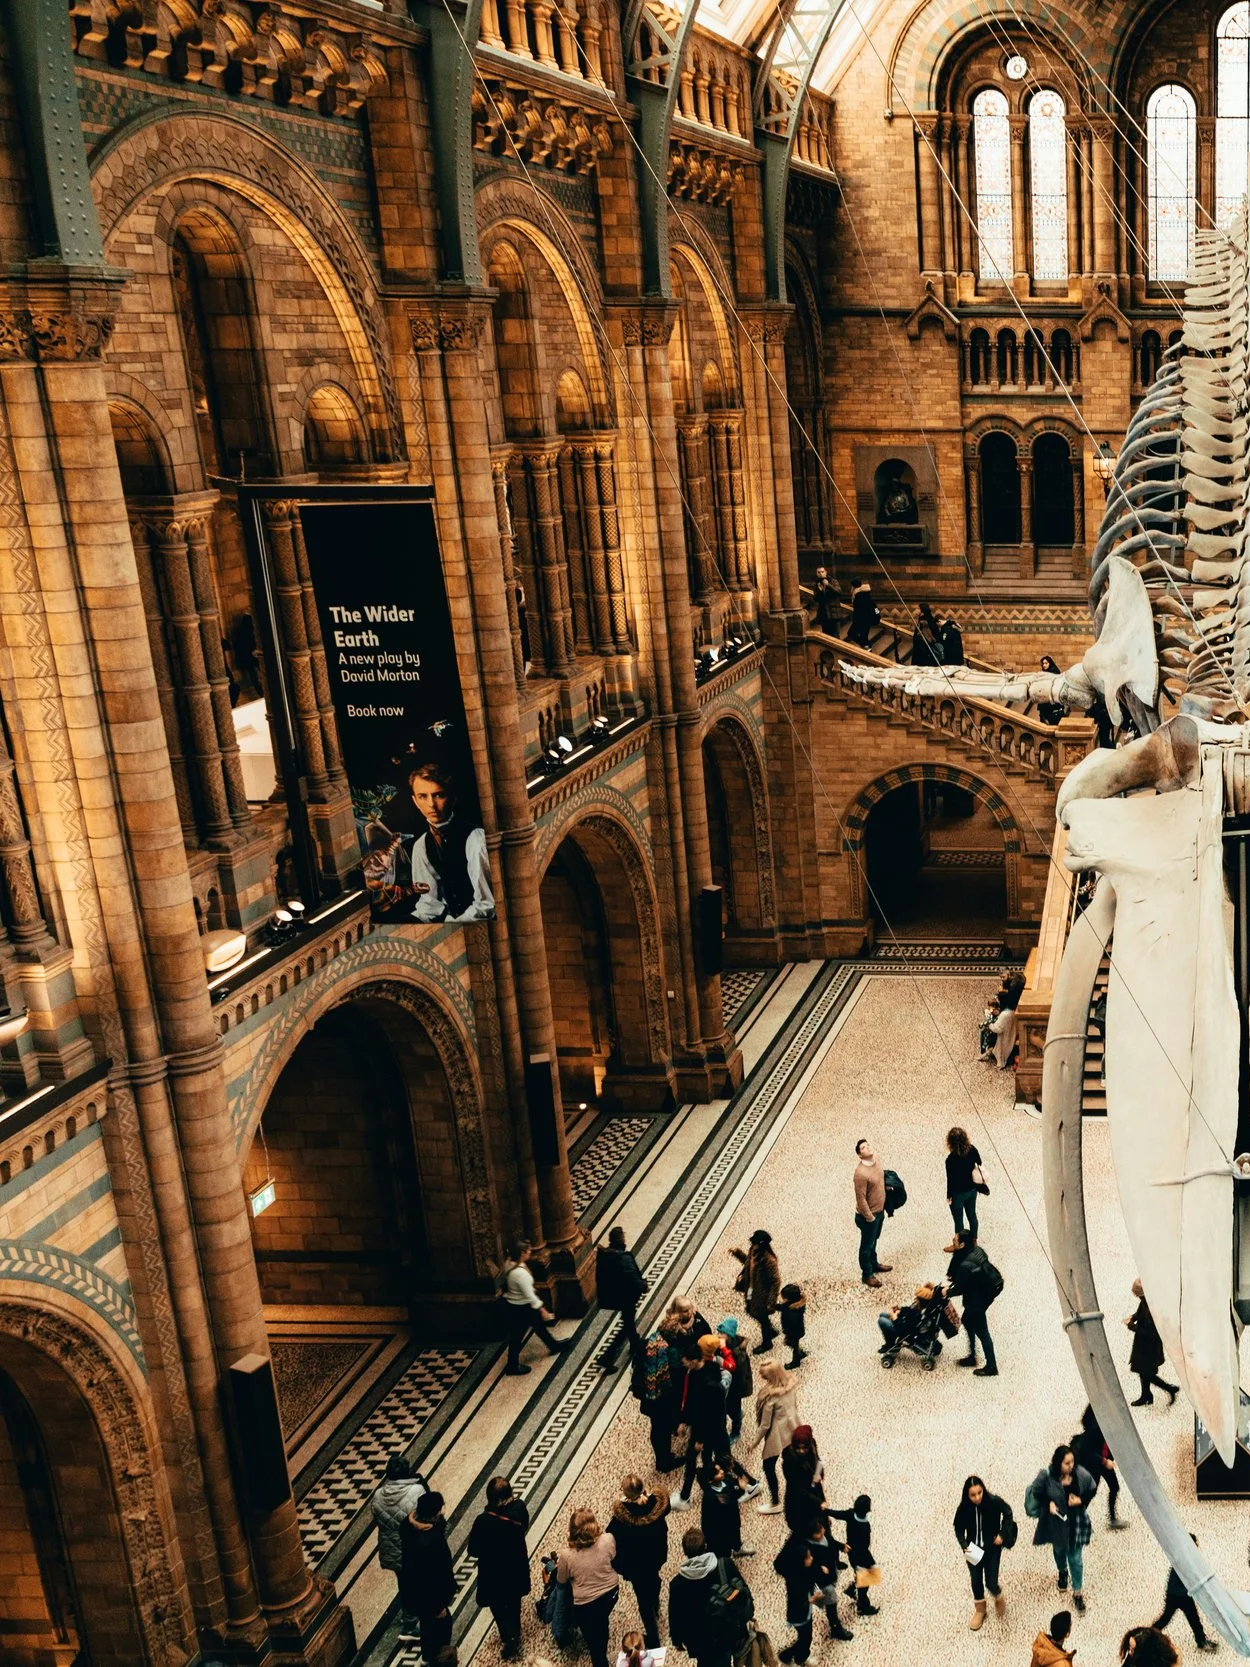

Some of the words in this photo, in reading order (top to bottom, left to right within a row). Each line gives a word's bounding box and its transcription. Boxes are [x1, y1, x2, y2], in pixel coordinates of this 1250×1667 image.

[329, 606, 362, 623] The
[364, 605, 415, 622] Wider
[334, 630, 380, 647] Earth
[338, 652, 348, 665] A
[350, 655, 374, 664] new
[377, 651, 403, 667] play
[405, 651, 421, 667] by
[341, 669, 375, 682] David
[377, 669, 420, 681] Morton
[347, 704, 377, 717] Book
[379, 706, 404, 716] now
